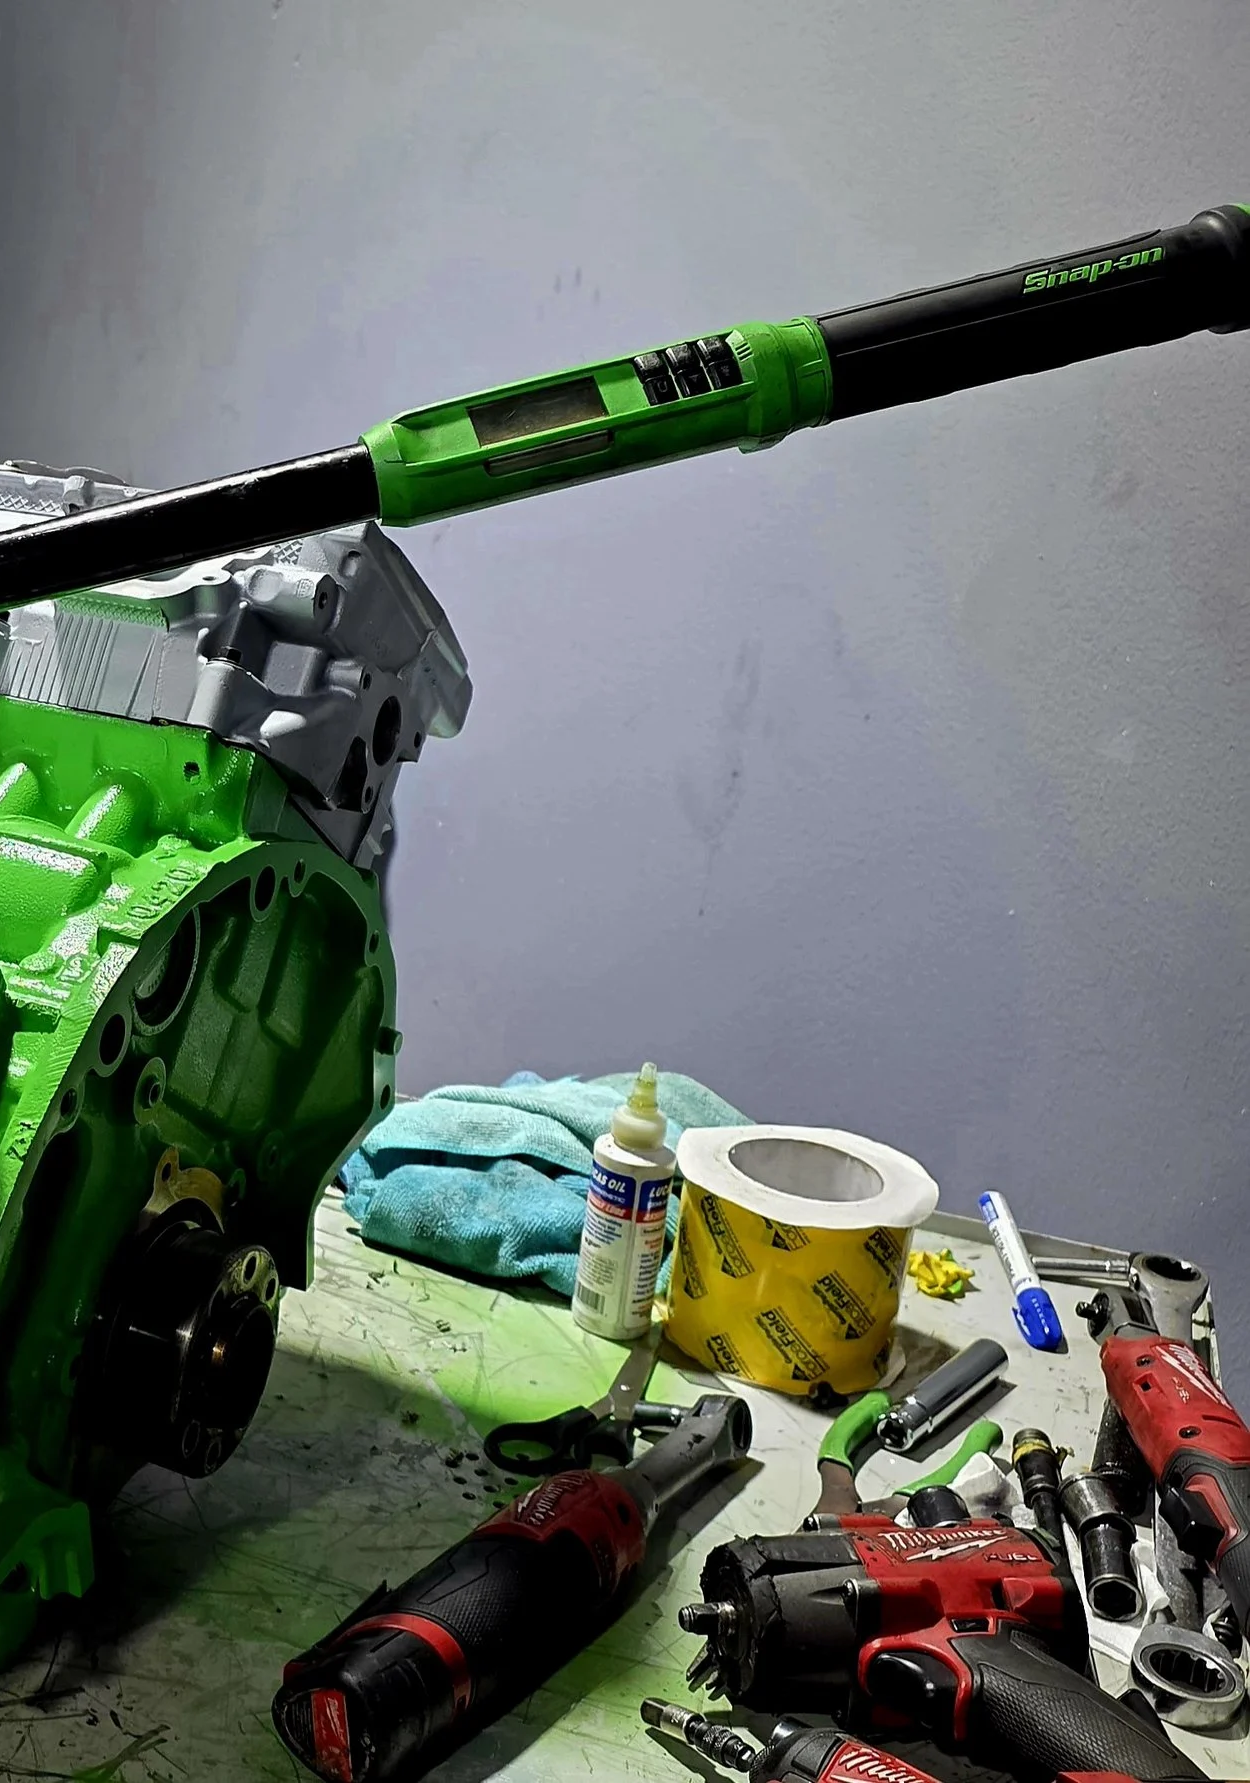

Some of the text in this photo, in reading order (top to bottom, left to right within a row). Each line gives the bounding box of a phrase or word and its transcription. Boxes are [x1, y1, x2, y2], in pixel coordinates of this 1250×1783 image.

[1023, 247, 1162, 294] Snap-on
[608, 1178, 626, 1193] OIL
[878, 1528, 1007, 1551] Milwaukee
